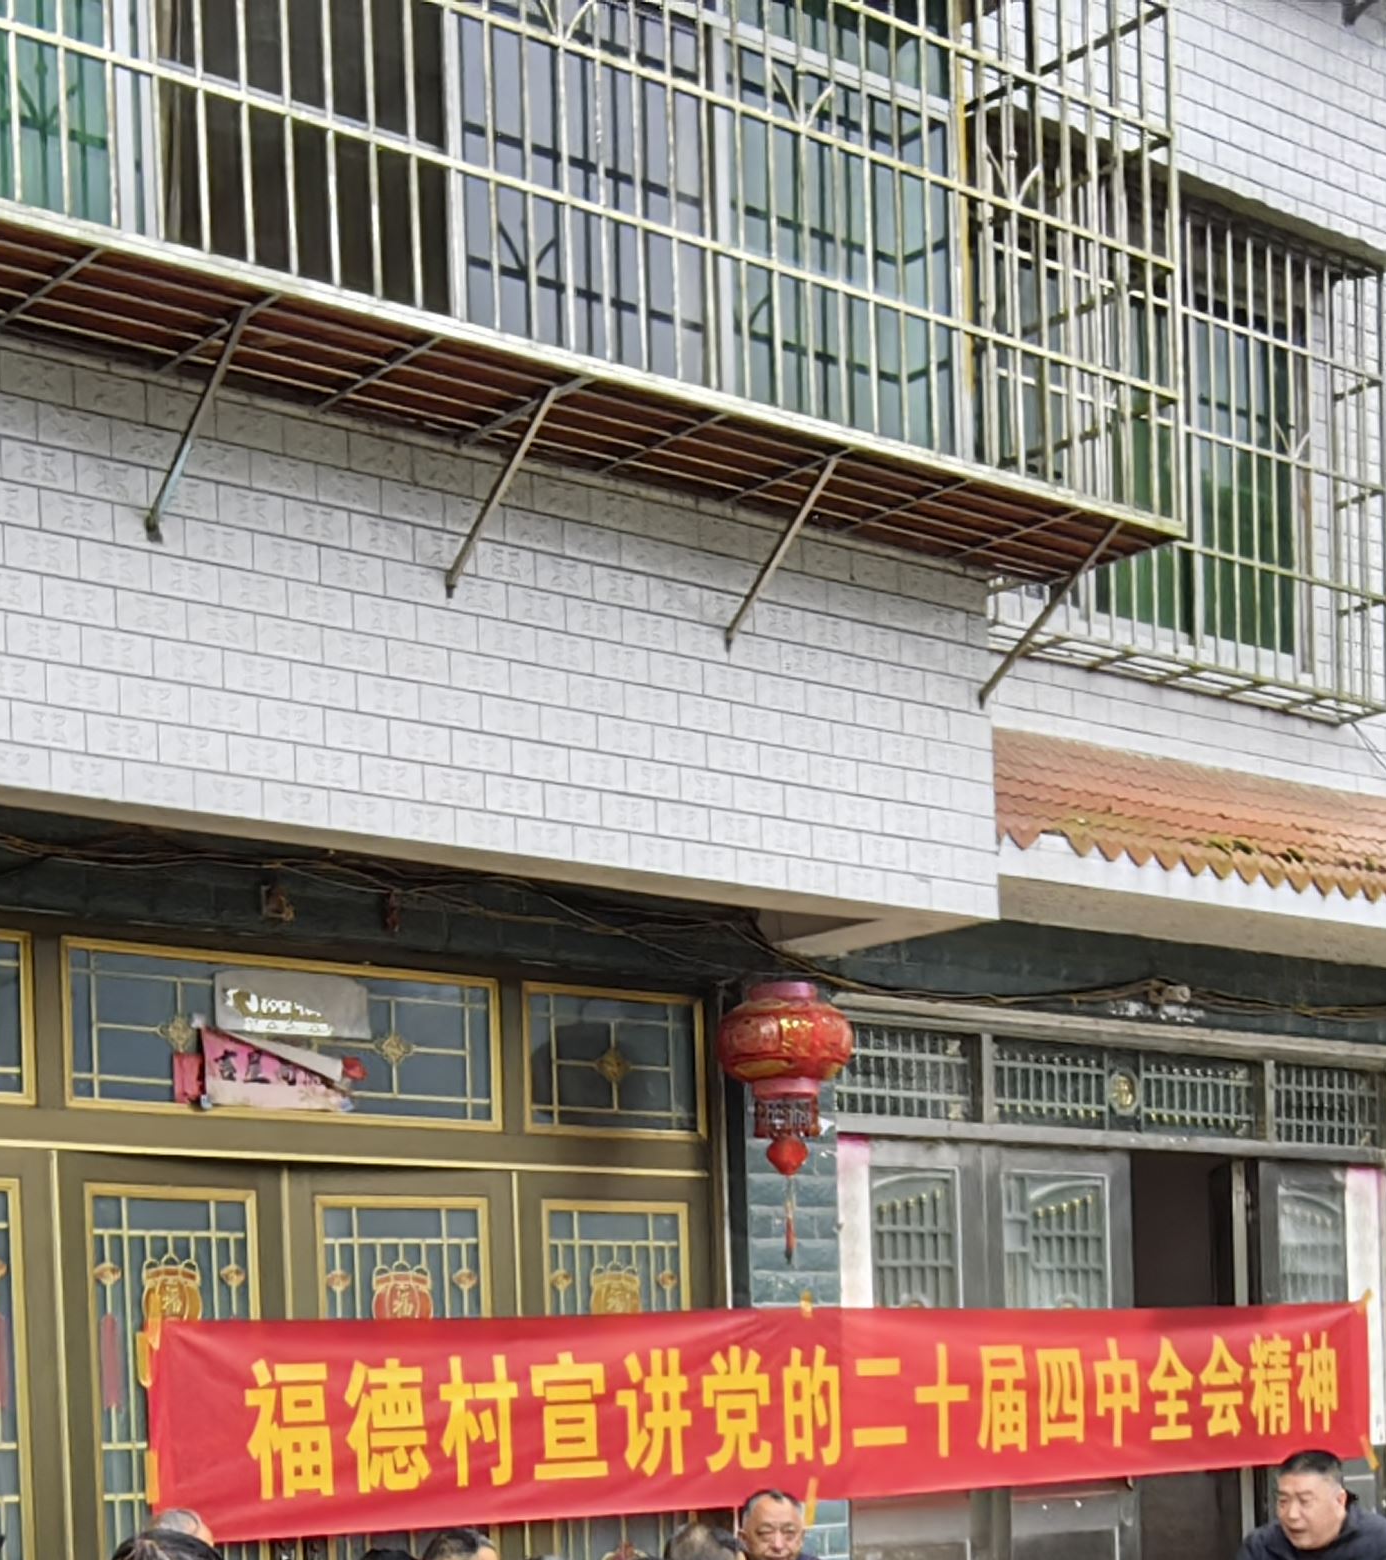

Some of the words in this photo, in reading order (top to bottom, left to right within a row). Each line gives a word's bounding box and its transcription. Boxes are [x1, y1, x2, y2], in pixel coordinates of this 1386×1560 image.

[244, 1330, 1338, 1500] 福德村宣讲党的二十届四中全会精神
